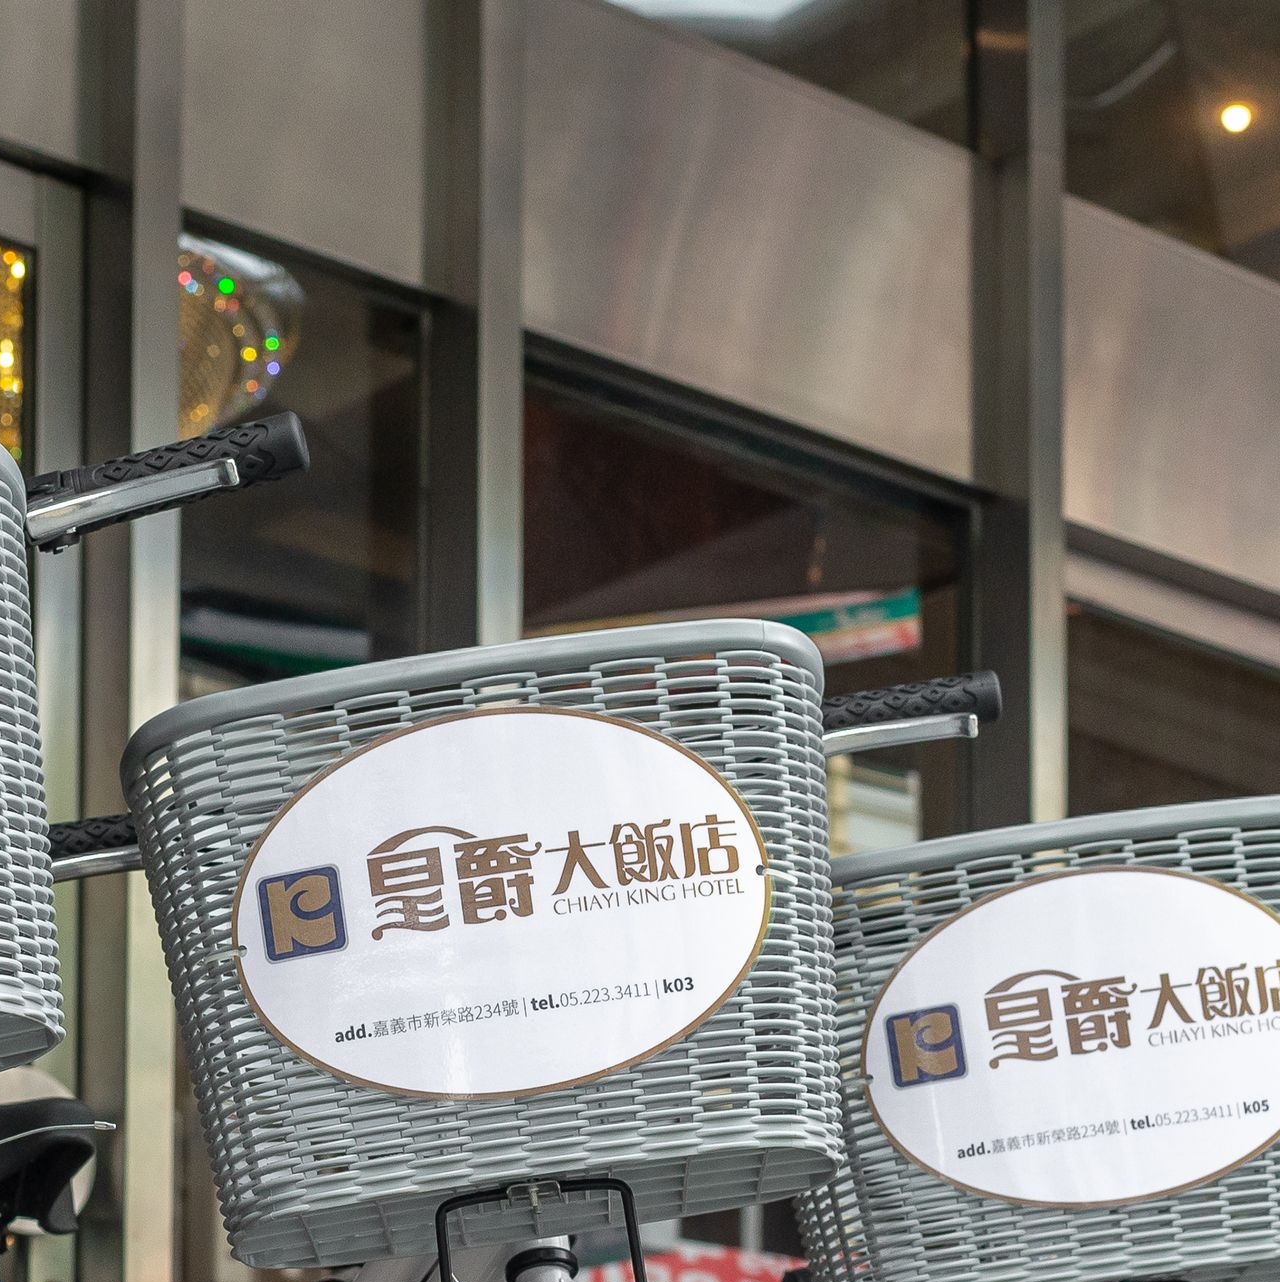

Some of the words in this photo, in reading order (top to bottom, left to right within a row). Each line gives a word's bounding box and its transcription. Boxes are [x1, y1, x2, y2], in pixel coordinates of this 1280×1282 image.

[367, 814, 739, 941] 皇爵大飯店
[553, 893, 620, 915] CHIAYI
[626, 884, 676, 907] KING
[681, 877, 744, 898] HOTEL
[662, 976, 694, 995] k03
[1148, 1027, 1205, 1047] CHIAYI
[1211, 1019, 1253, 1039] KING
[1243, 1098, 1270, 1115] k05
